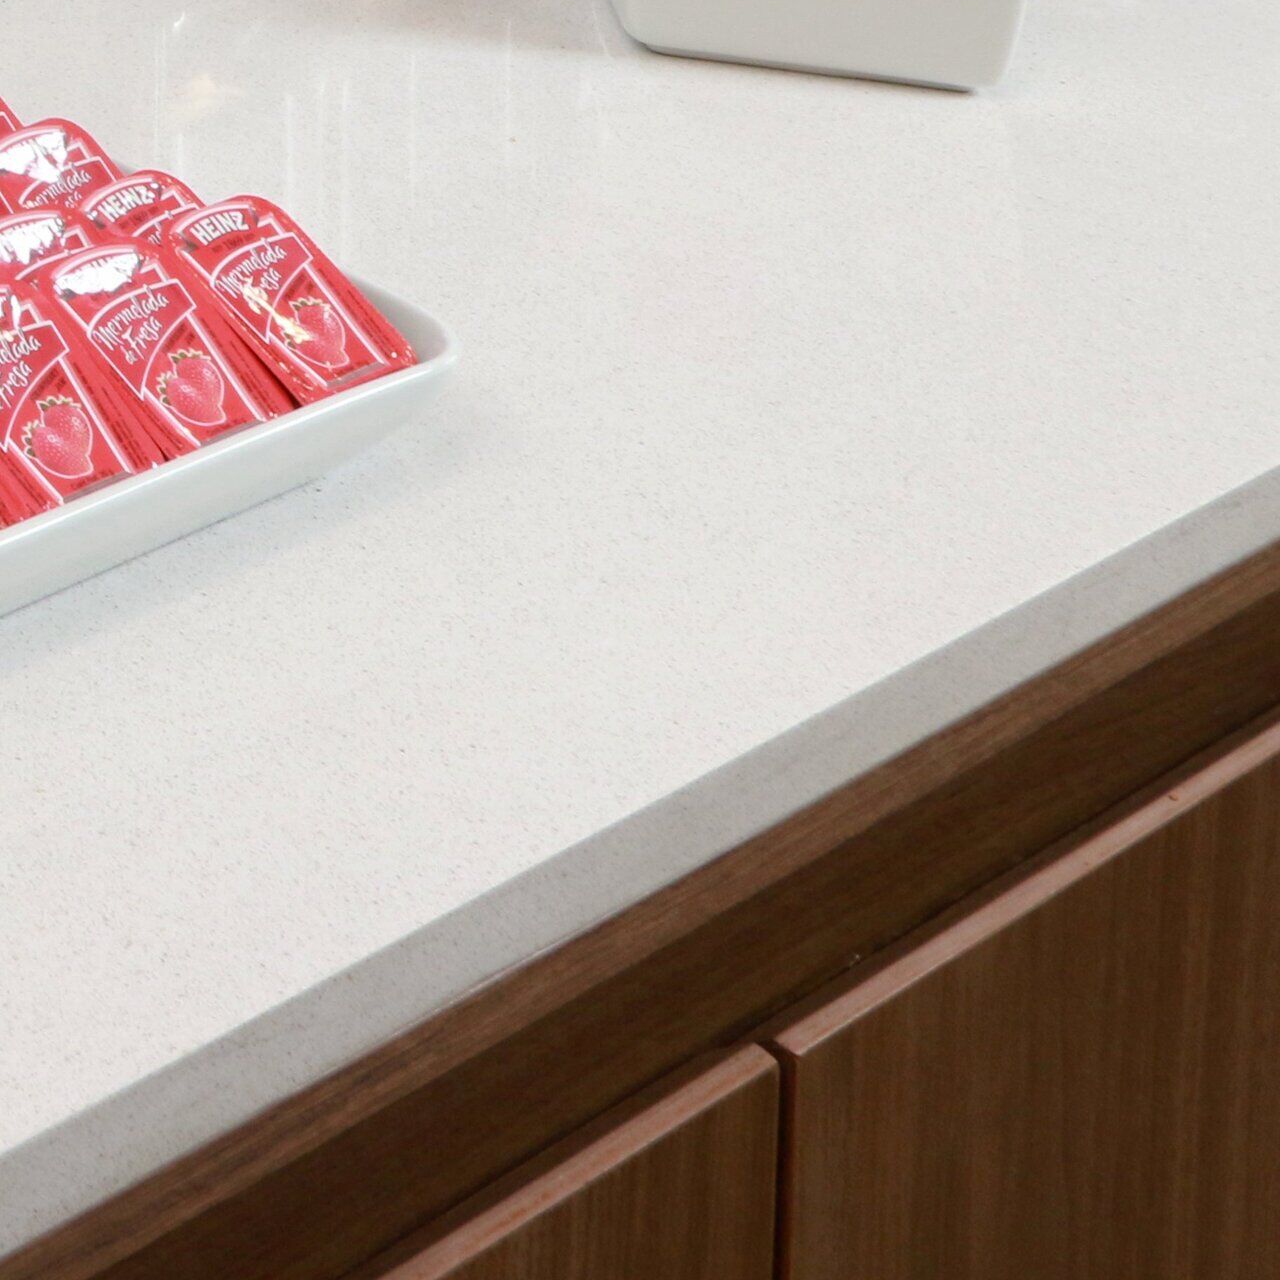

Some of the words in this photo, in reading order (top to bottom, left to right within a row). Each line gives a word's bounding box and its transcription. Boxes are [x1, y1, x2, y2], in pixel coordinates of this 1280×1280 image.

[190, 212, 249, 246] HEINZ
[215, 235, 288, 300] Mermelada
[93, 283, 169, 351] Mermelada
[121, 316, 162, 360] Fresa
